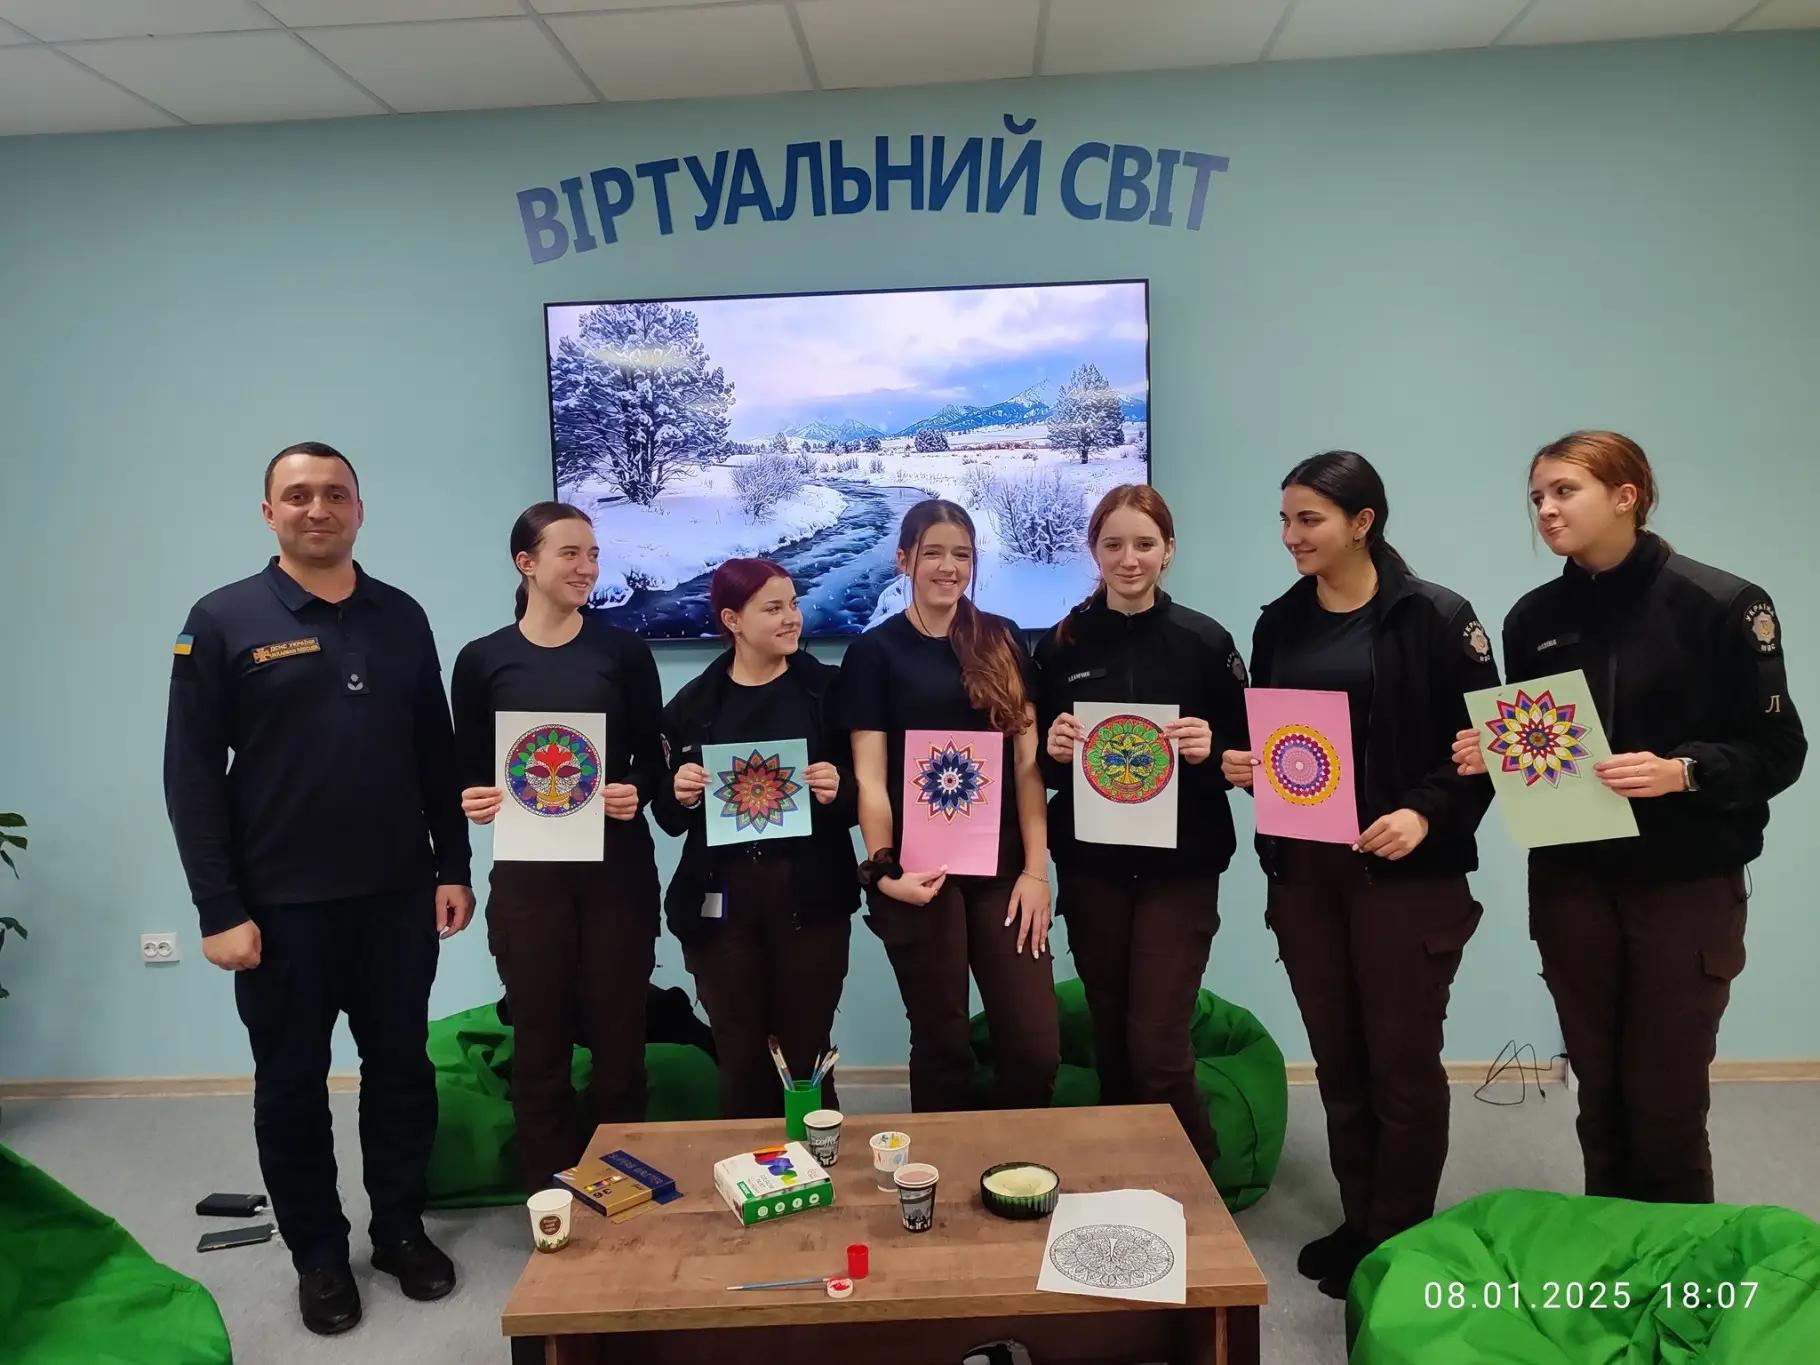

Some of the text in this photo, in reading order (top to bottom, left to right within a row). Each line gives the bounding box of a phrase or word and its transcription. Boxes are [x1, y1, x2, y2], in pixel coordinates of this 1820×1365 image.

[515, 113, 1230, 265] ВІРТУАЛЬНИЙ СВІТ
[1764, 694, 1781, 713] Л
[592, 1188, 613, 1199] 36
